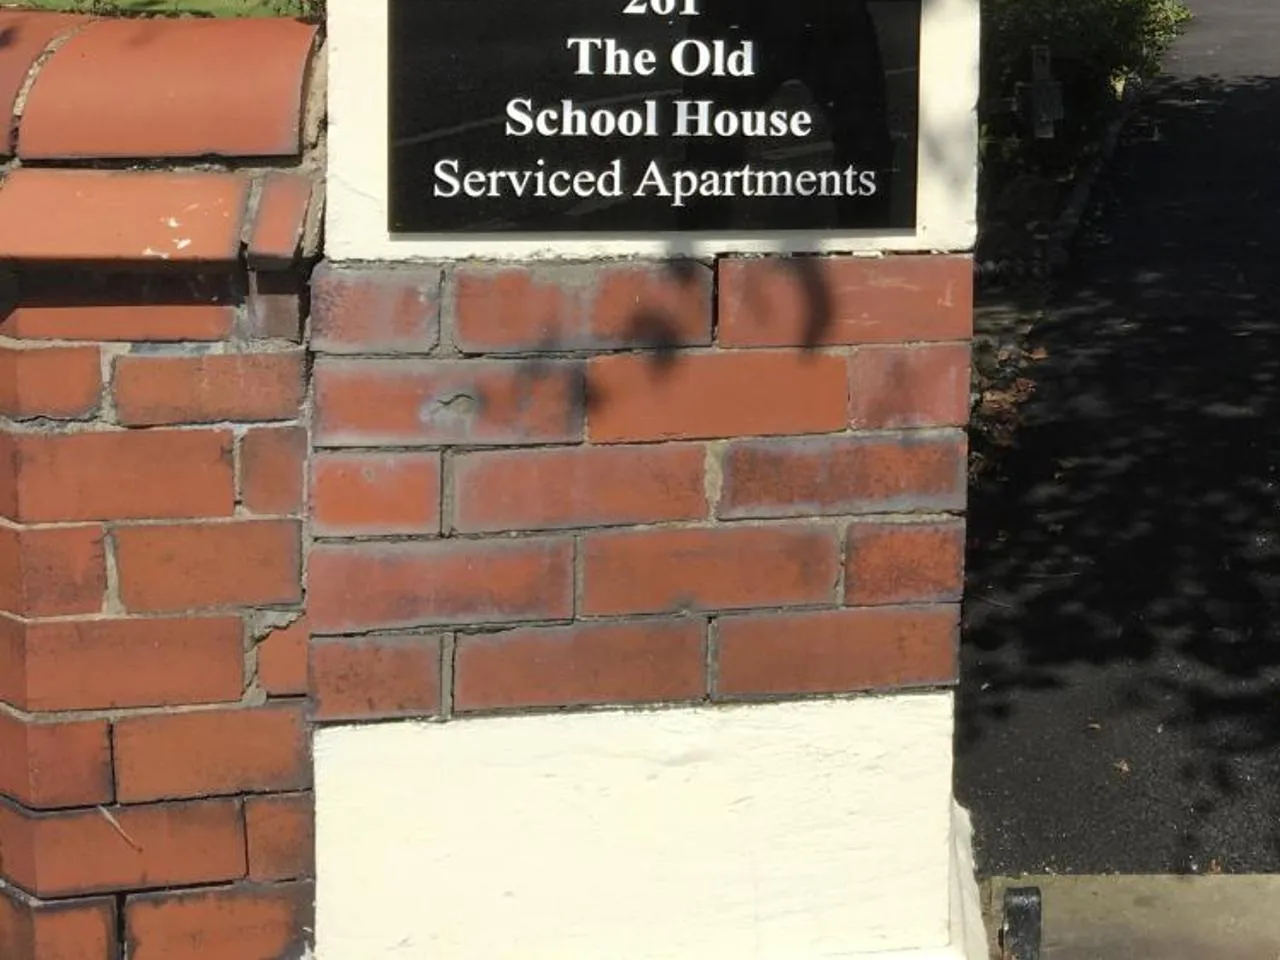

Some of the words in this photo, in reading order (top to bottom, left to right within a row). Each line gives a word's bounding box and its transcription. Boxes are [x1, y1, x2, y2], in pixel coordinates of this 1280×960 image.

[566, 36, 658, 77] The
[670, 38, 756, 77] Old
[504, 97, 659, 137] School
[671, 99, 813, 137] House
[432, 158, 625, 198] Serviced
[631, 159, 877, 207] Apartments
